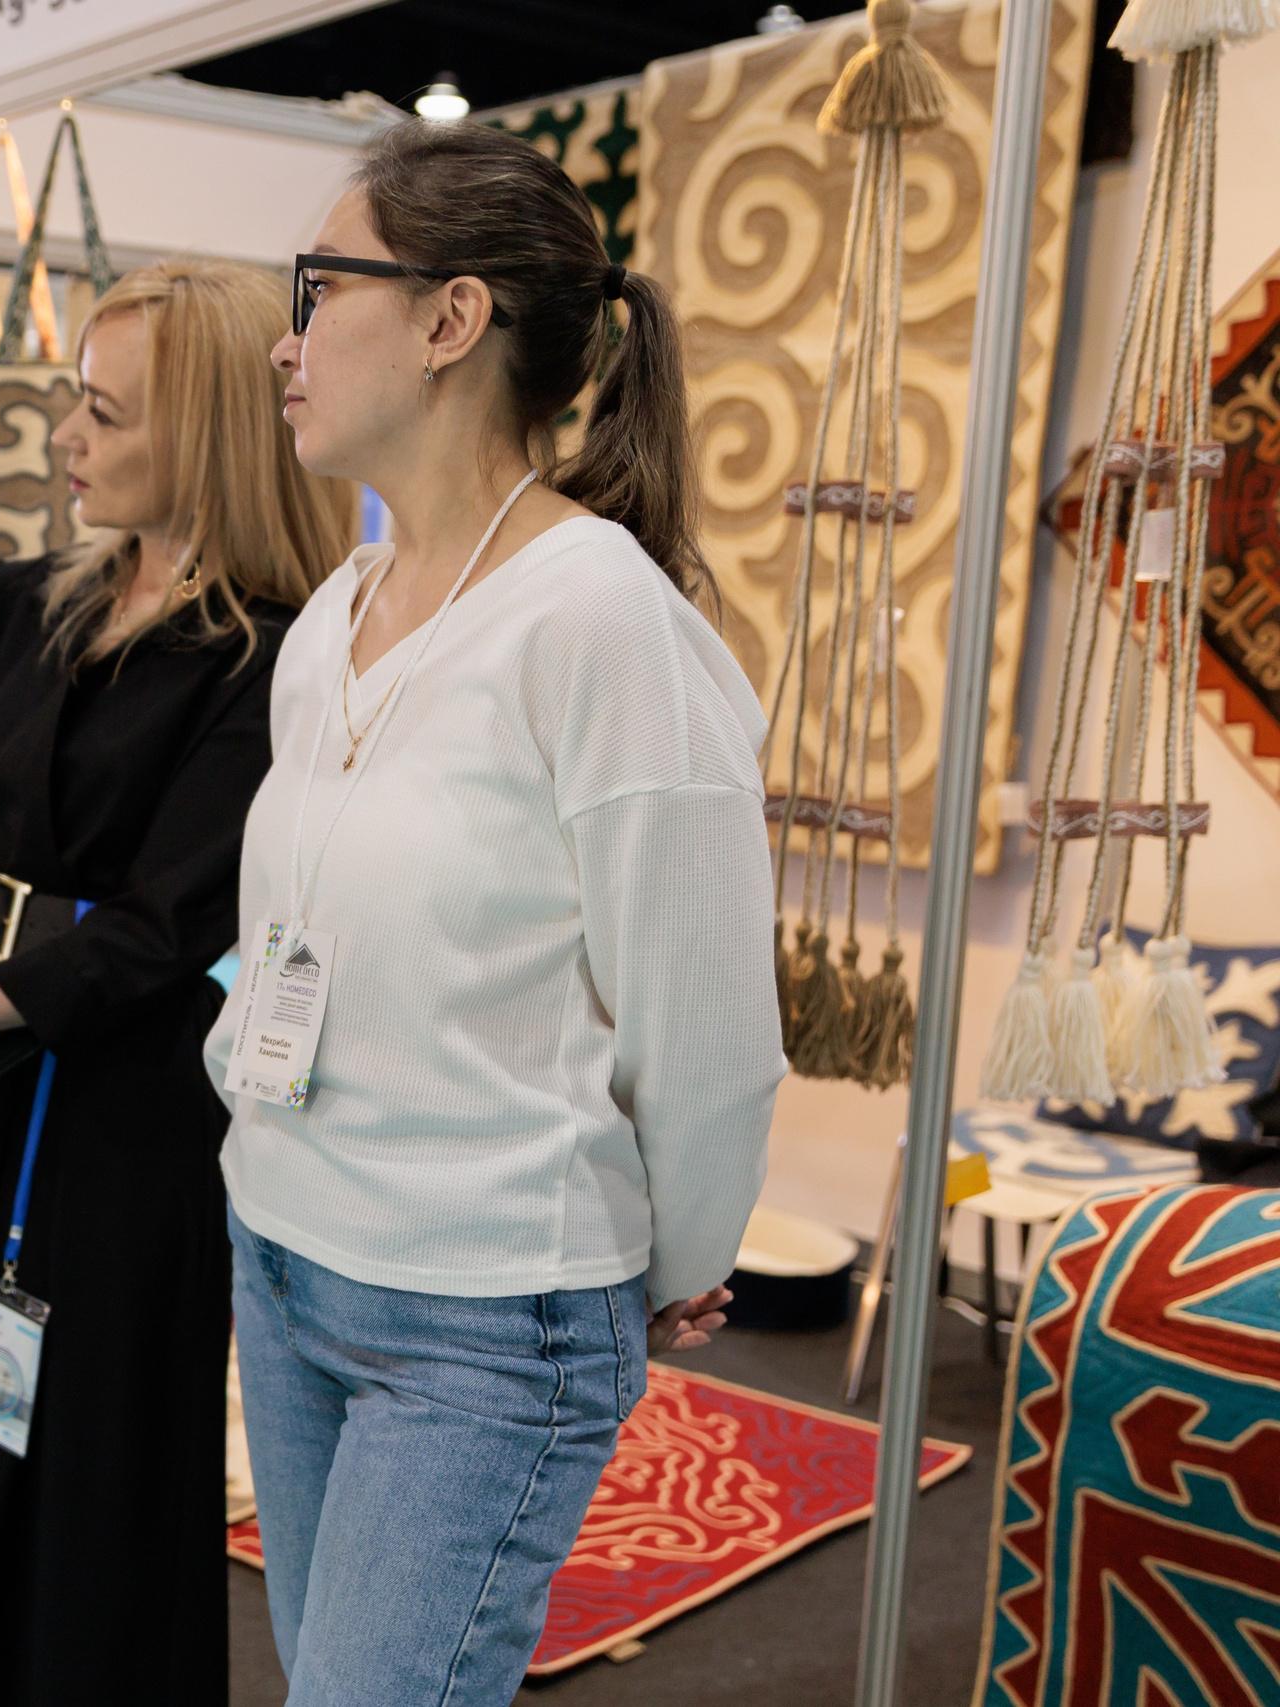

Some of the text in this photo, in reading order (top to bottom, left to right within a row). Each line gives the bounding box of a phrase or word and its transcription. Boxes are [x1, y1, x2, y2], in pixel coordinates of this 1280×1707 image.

[284, 962, 320, 978] HOMEDECO
[286, 984, 317, 998] HOMEDECO
[237, 1004, 252, 1056] ПОСЕТИТЕЛЬ
[261, 1034, 292, 1049] Мехрибан
[258, 1046, 289, 1060] Хамраева
